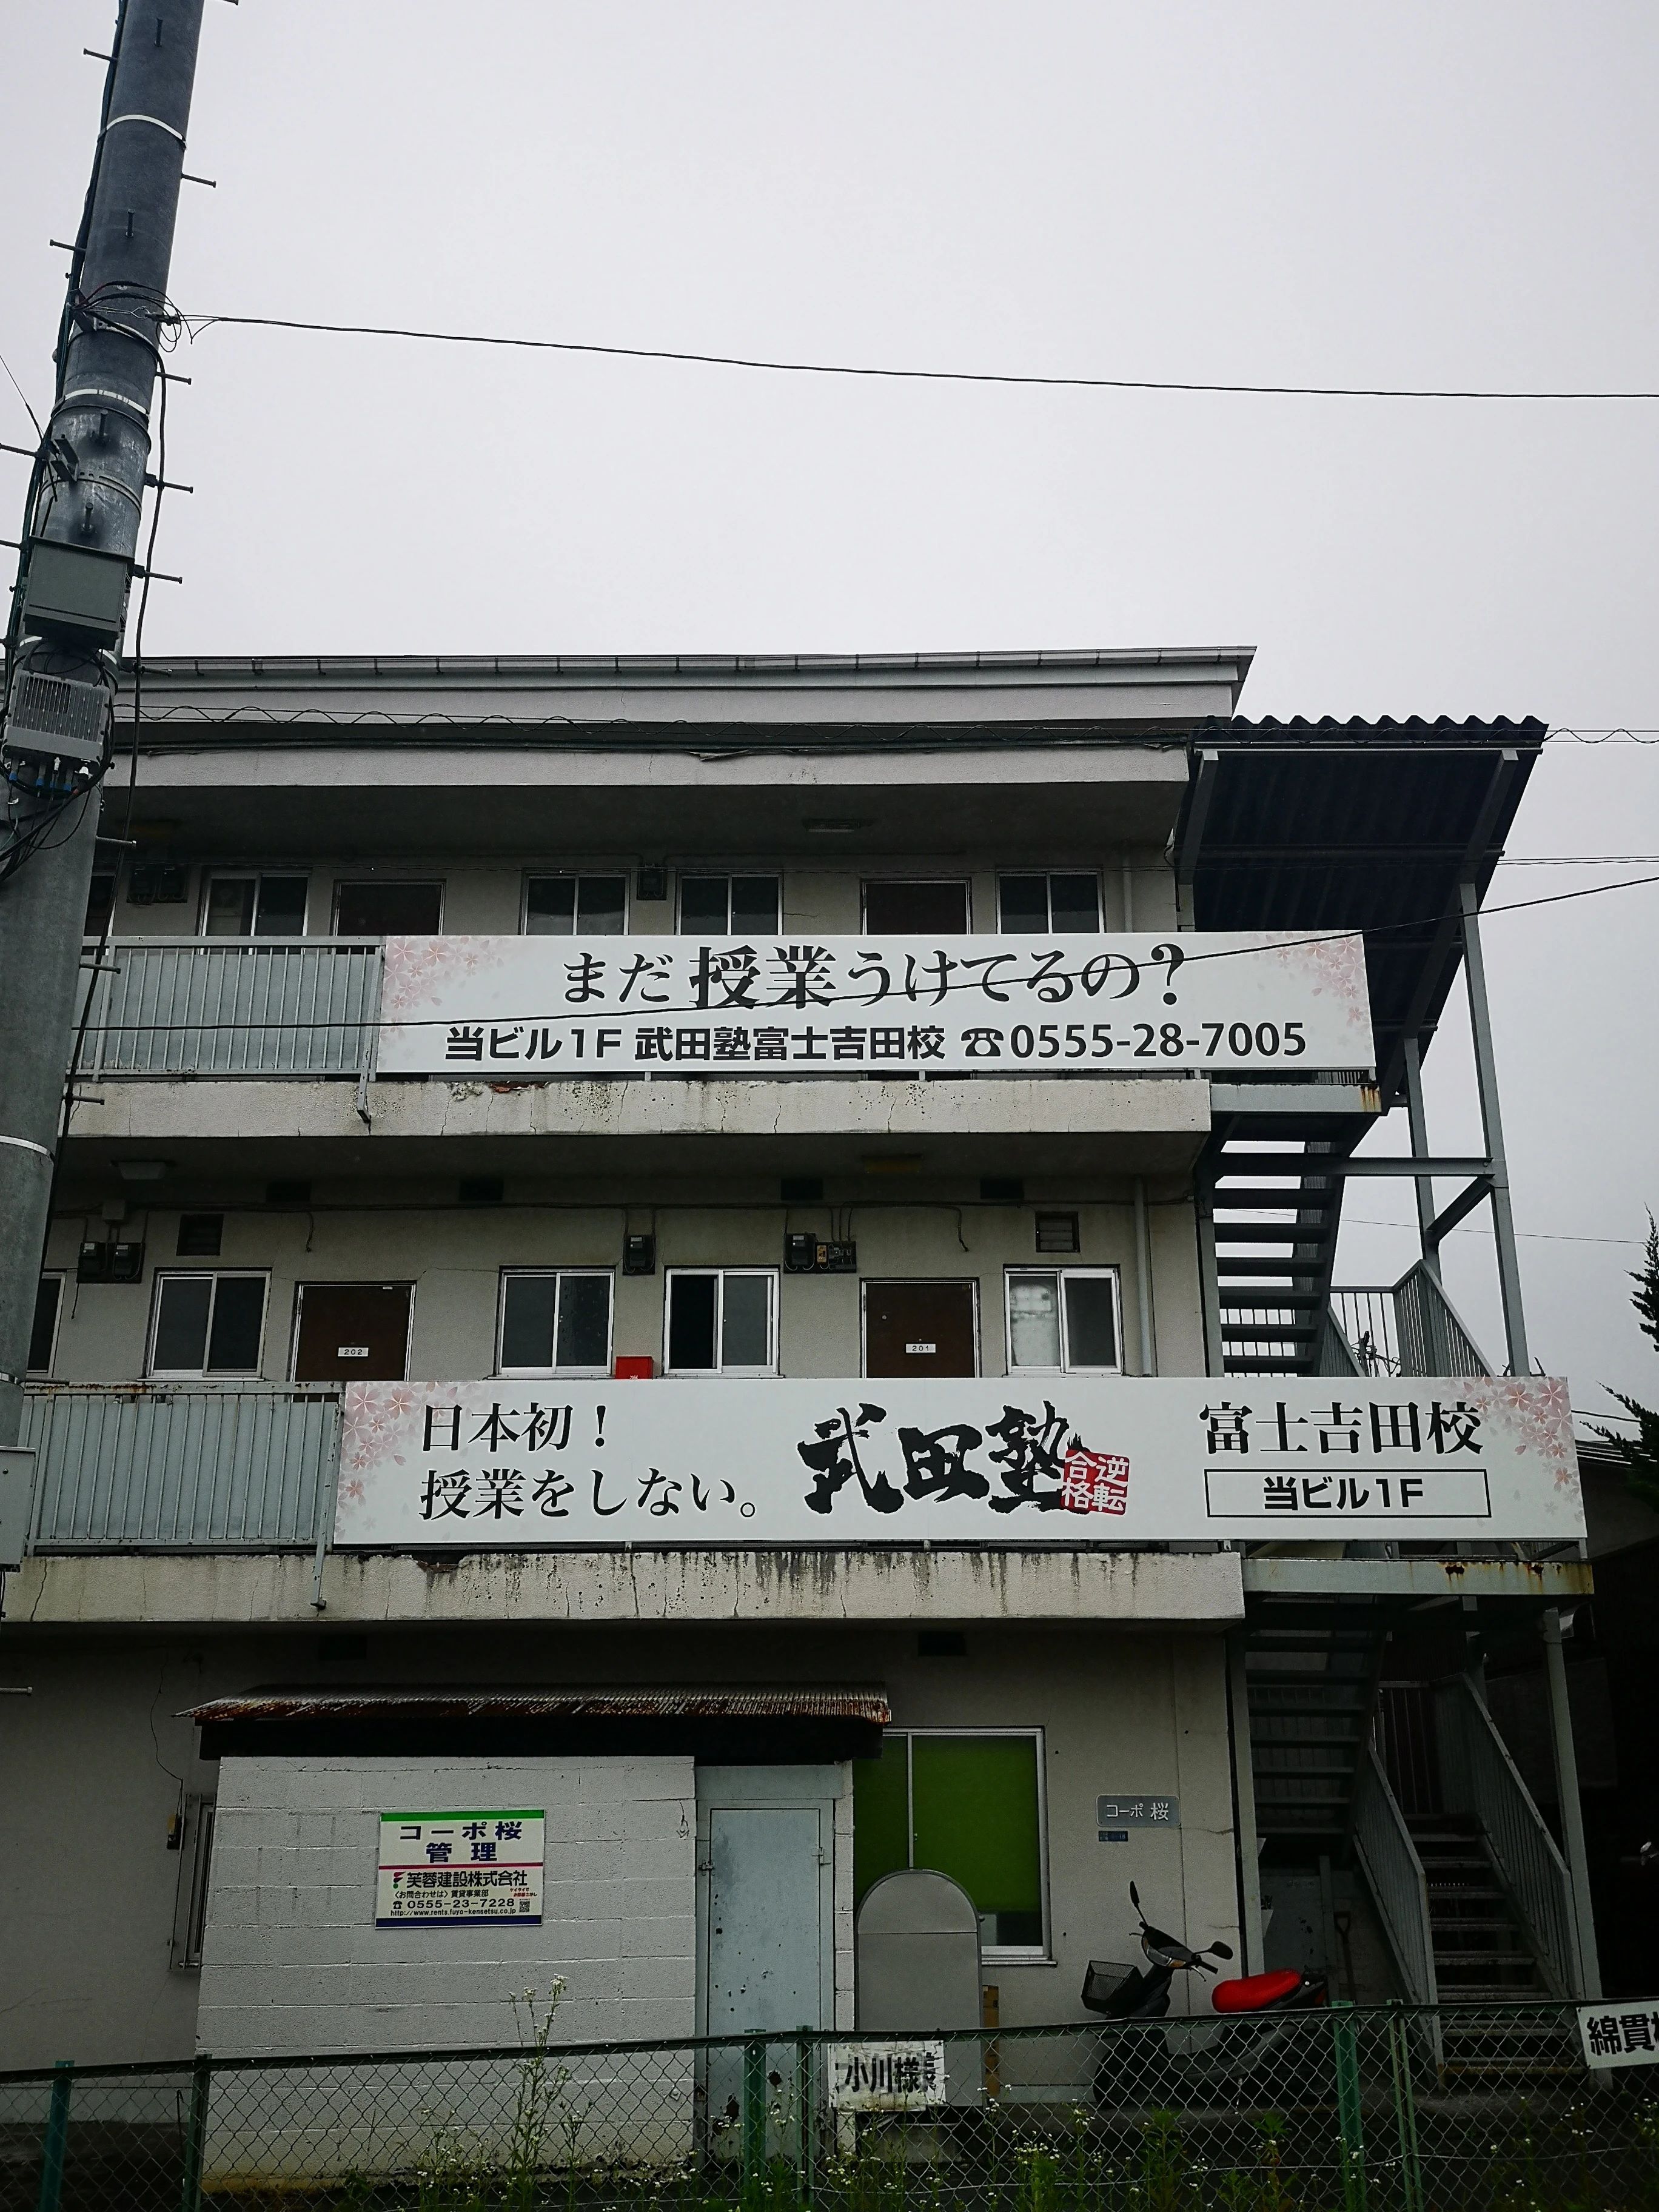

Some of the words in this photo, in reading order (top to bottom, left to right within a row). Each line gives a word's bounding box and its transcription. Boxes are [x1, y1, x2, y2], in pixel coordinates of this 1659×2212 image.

[446, 1027, 621, 1061] 当ビル1F
[635, 1025, 945, 1061] 武田塾富士吉田校
[1011, 1023, 1305, 1057] 0555-28-7005
[423, 1402, 606, 1452] 日本初！
[1199, 1401, 1483, 1454] 富士吉田校
[796, 1399, 1091, 1515] 武田塾
[419, 1468, 755, 1520] 授業をしない。
[1264, 1476, 1423, 1510] 当ビル1F
[400, 1821, 523, 1841] コーポ桜
[406, 1869, 528, 1889] 芙蓉建設株式会社
[407, 1898, 515, 1909] 0555-23-7228
[1587, 2011, 1659, 2056] 綿貫
